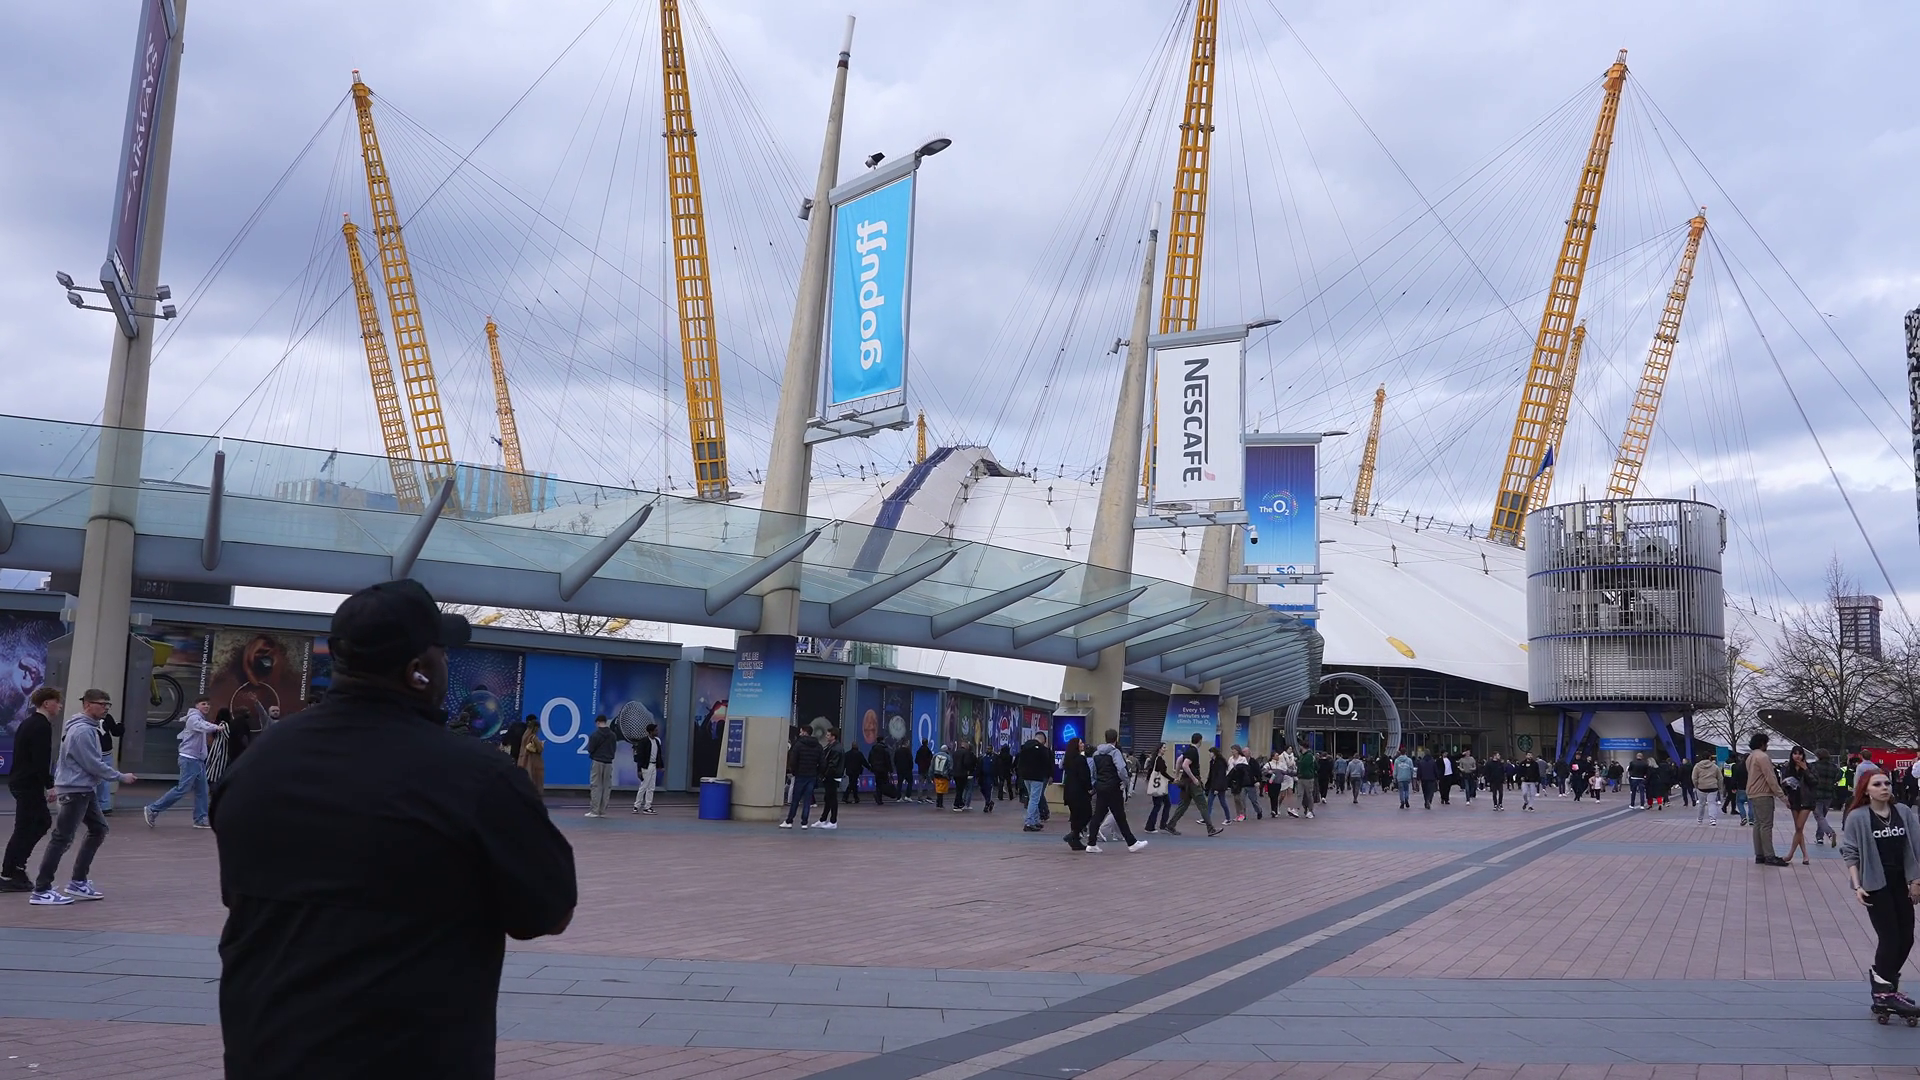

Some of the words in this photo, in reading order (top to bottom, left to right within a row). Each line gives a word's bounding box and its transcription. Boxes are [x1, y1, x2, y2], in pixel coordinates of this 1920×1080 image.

[856, 218, 888, 371] gopuff
[199, 666, 207, 694] ESSENTIAL
[1314, 704, 1334, 715] The
[1153, 778, 1161, 788] S
